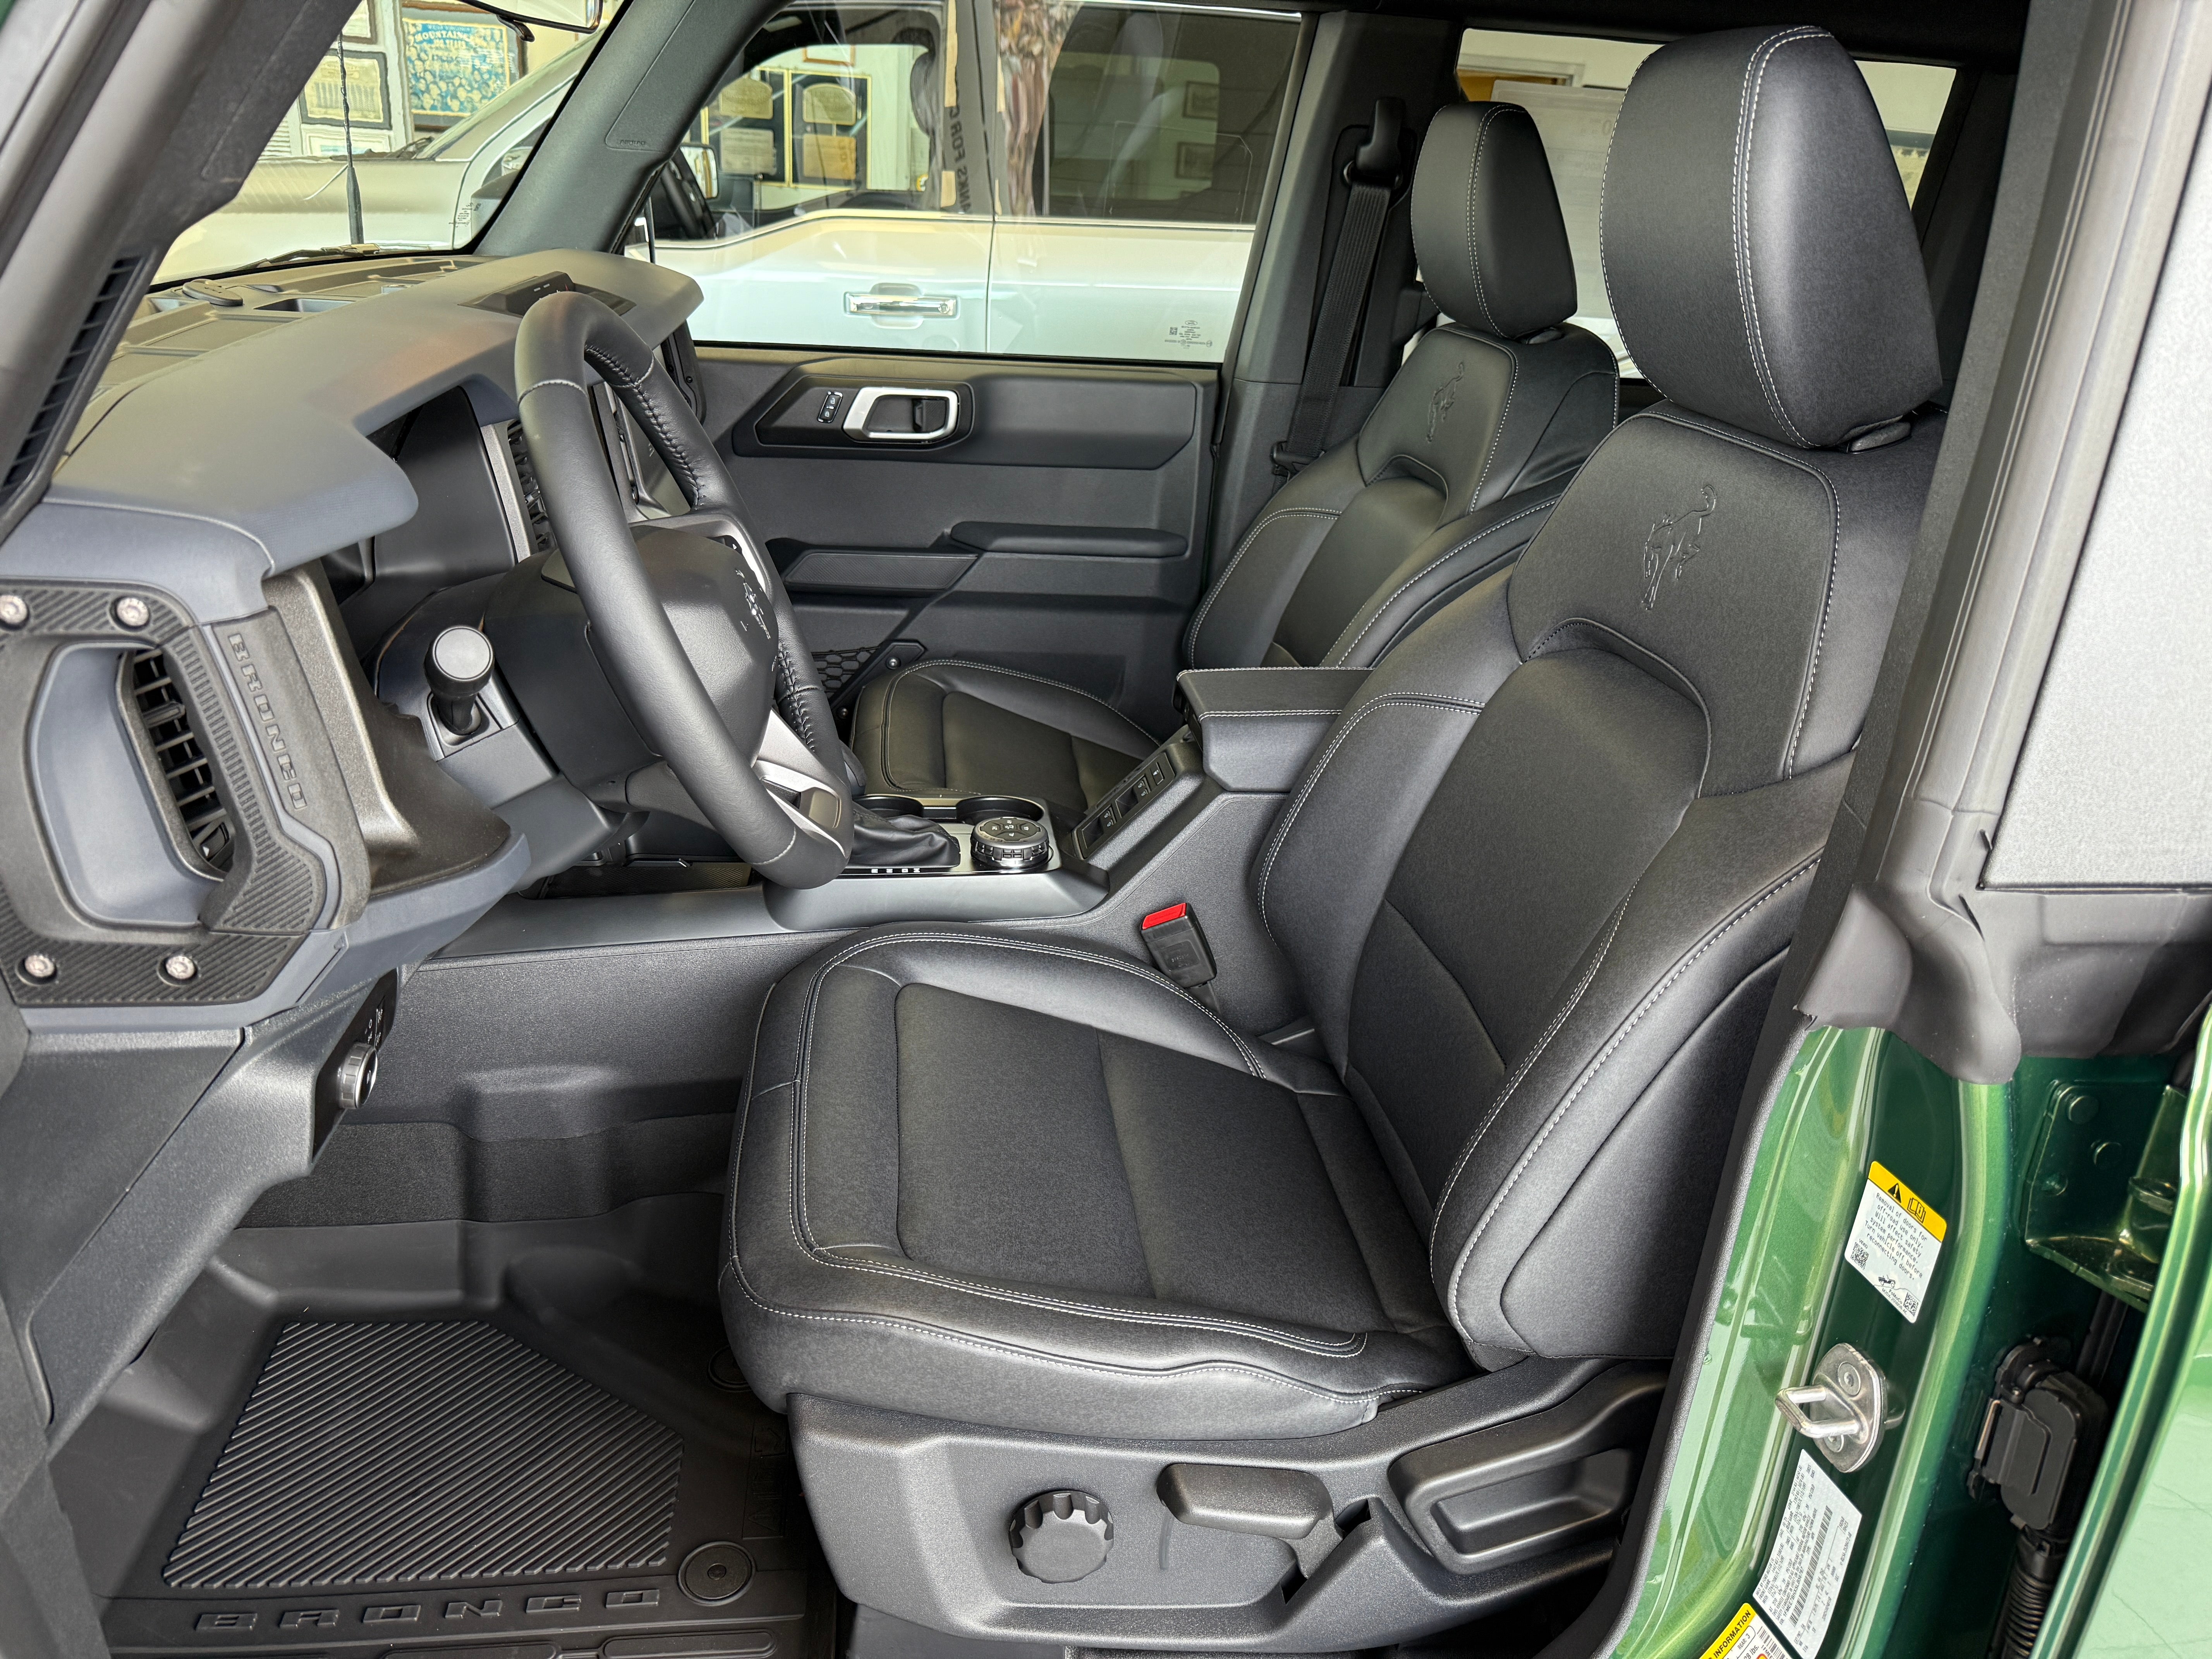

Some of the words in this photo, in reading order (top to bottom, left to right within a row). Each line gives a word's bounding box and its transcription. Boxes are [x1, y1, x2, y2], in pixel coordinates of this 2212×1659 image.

[228, 633, 307, 810] BRONCO
[1874, 1210, 1886, 1224] Will
[1887, 1222, 1904, 1241] affect
[1904, 1238, 1922, 1259] safety
[1875, 1192, 1895, 1213] Removal
[1895, 1209, 1901, 1219] of
[1902, 1216, 1917, 1233] doors
[1918, 1231, 1928, 1242] for
[1877, 1203, 1899, 1226] off-road
[1899, 1224, 1908, 1236] use
[1909, 1233, 1924, 1251] only.
[1858, 1238, 1868, 1249] VIDEO
[1864, 1219, 1875, 1234] Turn
[1876, 1231, 1895, 1252] vehicle
[1896, 1249, 1905, 1261] off
[1906, 1259, 1923, 1279] before
[1866, 1233, 1898, 1266] reconnecting
[1898, 1262, 1915, 1281] doors.
[1869, 1217, 1886, 1235] system
[1886, 1233, 1919, 1266] performance.
[195, 1589, 660, 1630] BRONCO
[1775, 1607, 1783, 1622] SAFETY
[1776, 1594, 1784, 1611] VEHICLE
[1783, 1565, 1805, 1620] 1FMEE7BHXSLB56787
[1712, 1610, 1752, 1658] INFORMATION
[1737, 1637, 1747, 1650] REAR:
[1749, 1643, 1759, 1656] lbs.
